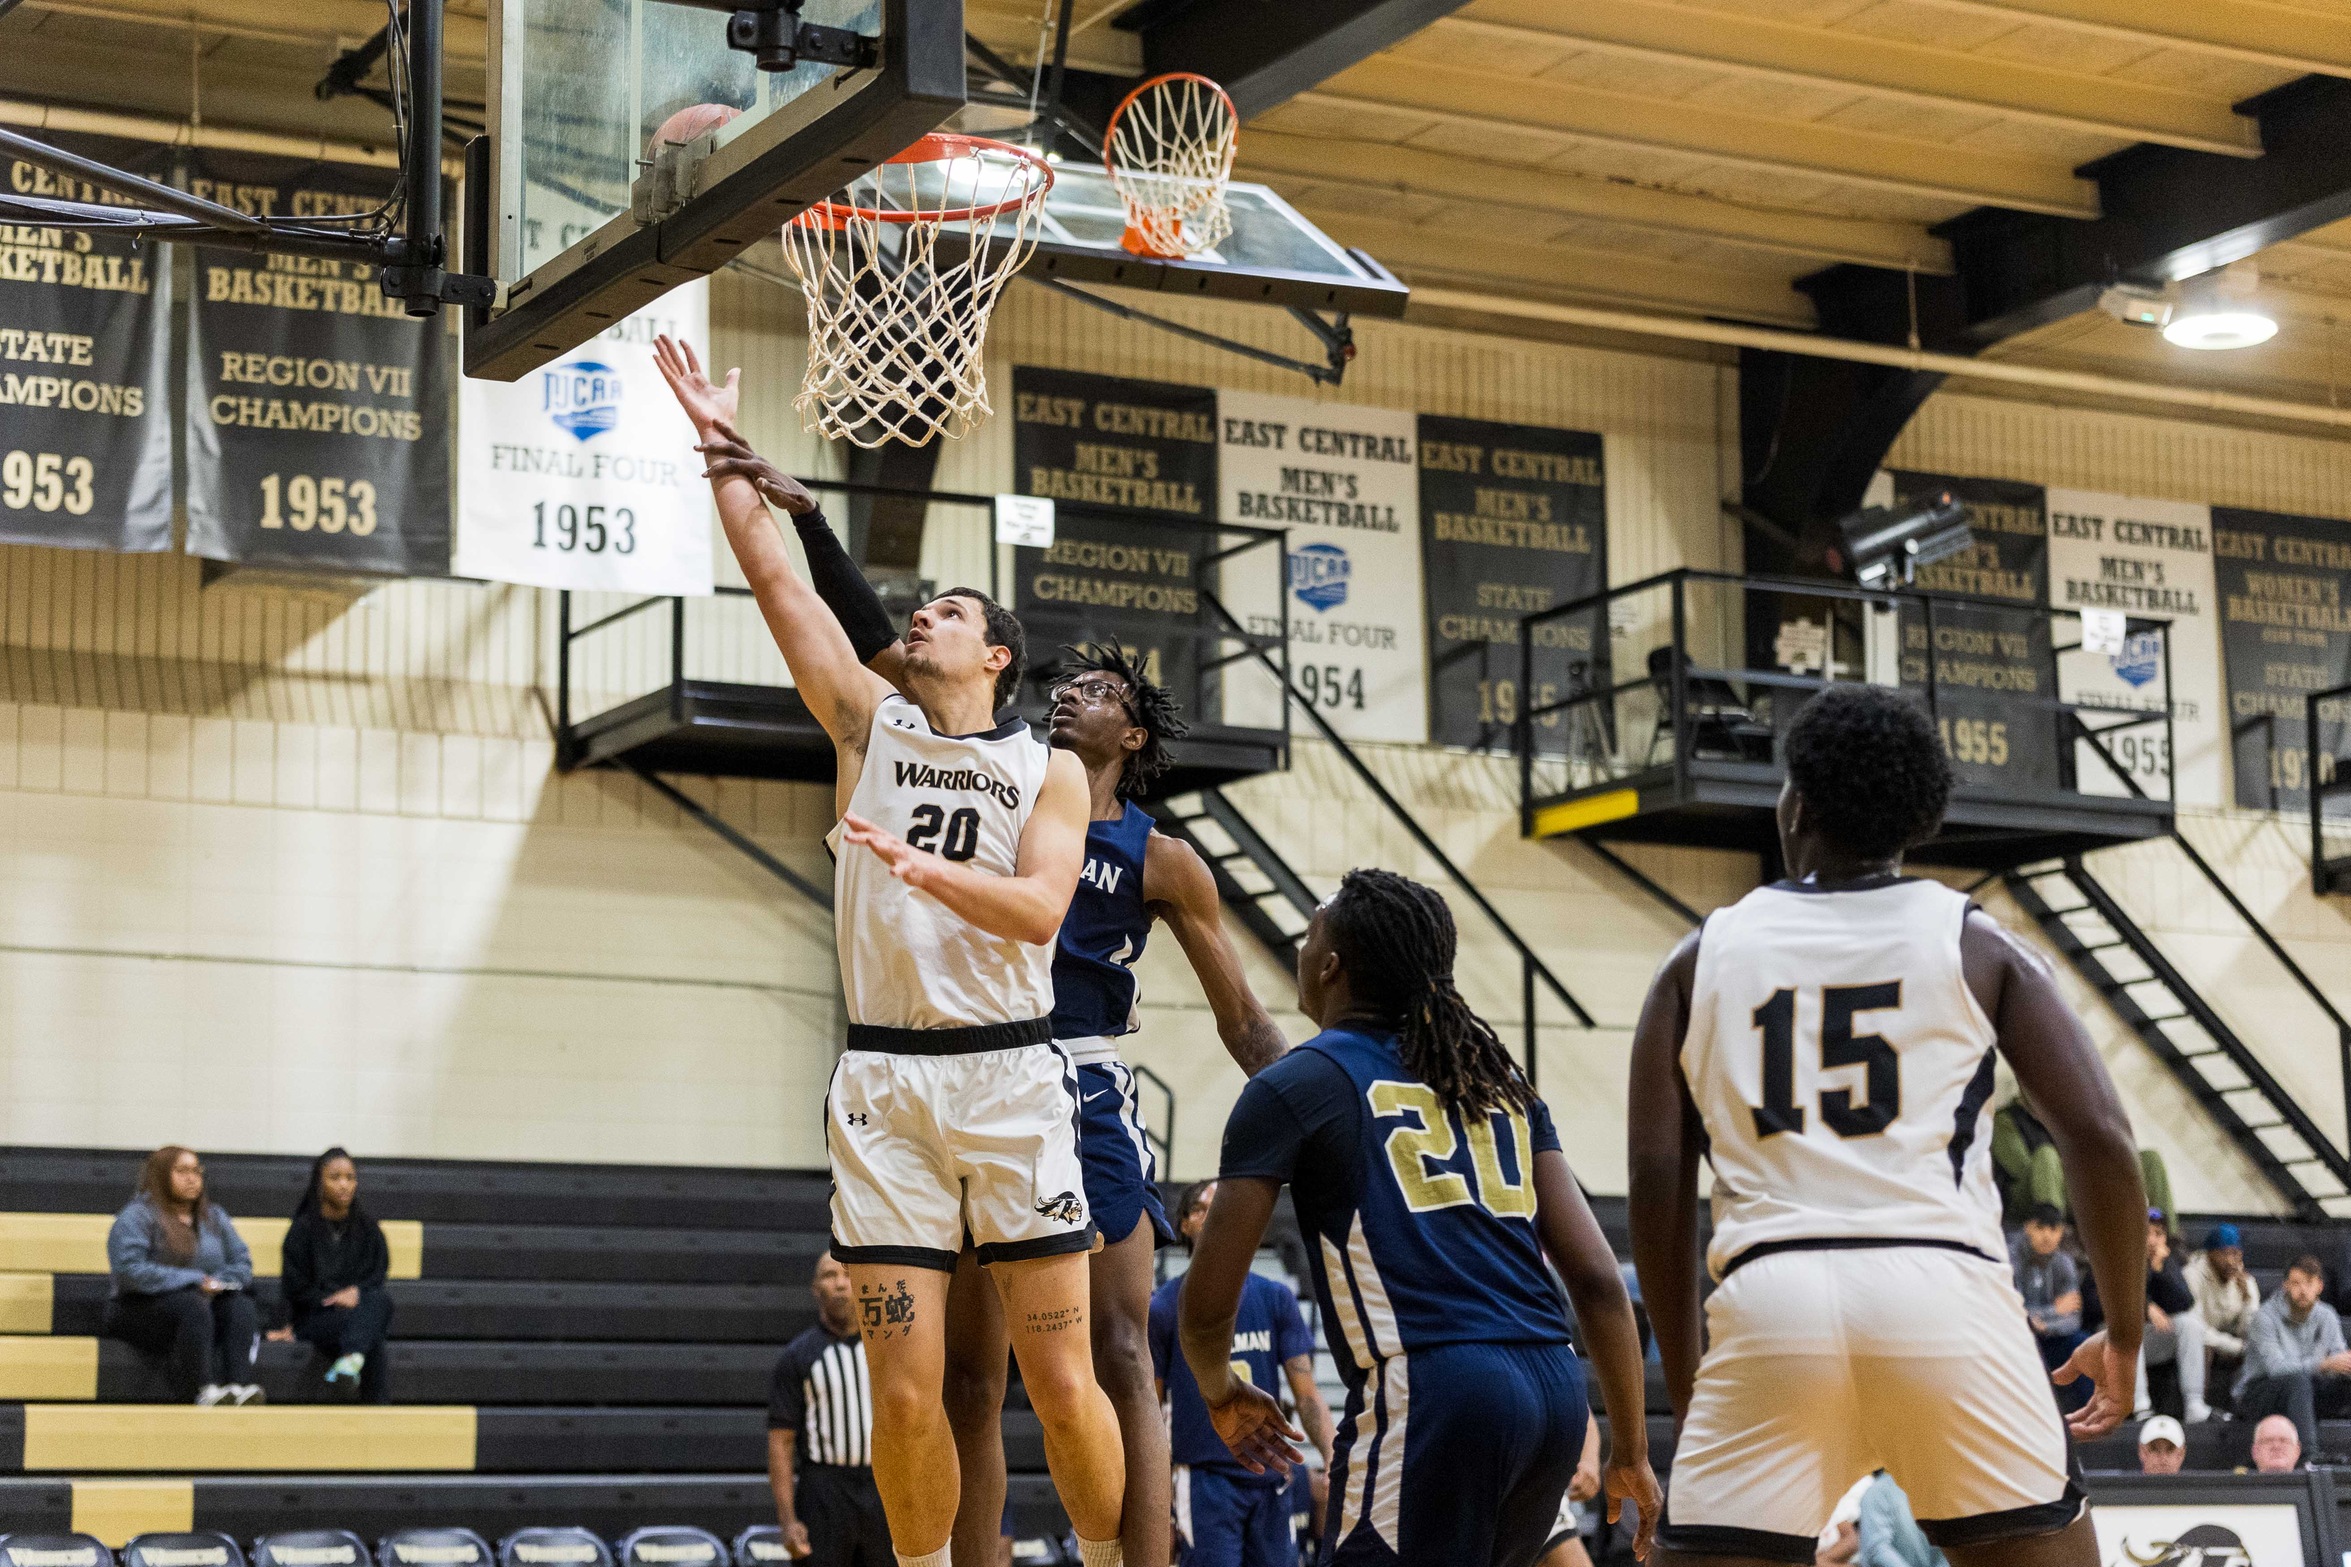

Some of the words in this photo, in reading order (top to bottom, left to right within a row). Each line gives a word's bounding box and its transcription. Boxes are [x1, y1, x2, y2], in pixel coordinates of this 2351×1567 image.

[207, 266, 427, 322] BASKETBAL
[0, 328, 94, 367] TATE
[220, 351, 361, 392] REGION
[365, 364, 412, 397] VII
[210, 394, 423, 442] CHAMPIONS
[1017, 392, 1084, 428] EAST
[1094, 402, 1216, 443] CENTRAL
[1224, 418, 1287, 449] EAST
[1299, 427, 1412, 464] CENTRAL
[491, 446, 584, 479] FINAL
[593, 455, 680, 487] FOUR
[1074, 442, 1159, 479] MEN'S
[1280, 466, 1358, 499] MEN'S
[1421, 440, 1481, 474] EAST
[1491, 448, 1601, 487] CENTRAL
[260, 473, 378, 537] 1953
[1030, 466, 1200, 514] BASKETBALL
[1238, 491, 1399, 533] BASKETBALL
[533, 502, 637, 553] 1953
[2053, 513, 2103, 541] EAST
[2114, 519, 2208, 553] CENTRAL
[1153, 551, 1190, 577] VII
[1033, 573, 1198, 615] CHAMPIONS
[1328, 621, 1398, 650] FOUR
[1301, 663, 1366, 711] 954
[1477, 678, 1561, 729] 195
[895, 760, 1021, 811] WARRIORS
[905, 803, 982, 863] 20
[1750, 978, 1904, 1141] 15
[1366, 1079, 1538, 1222] 20
